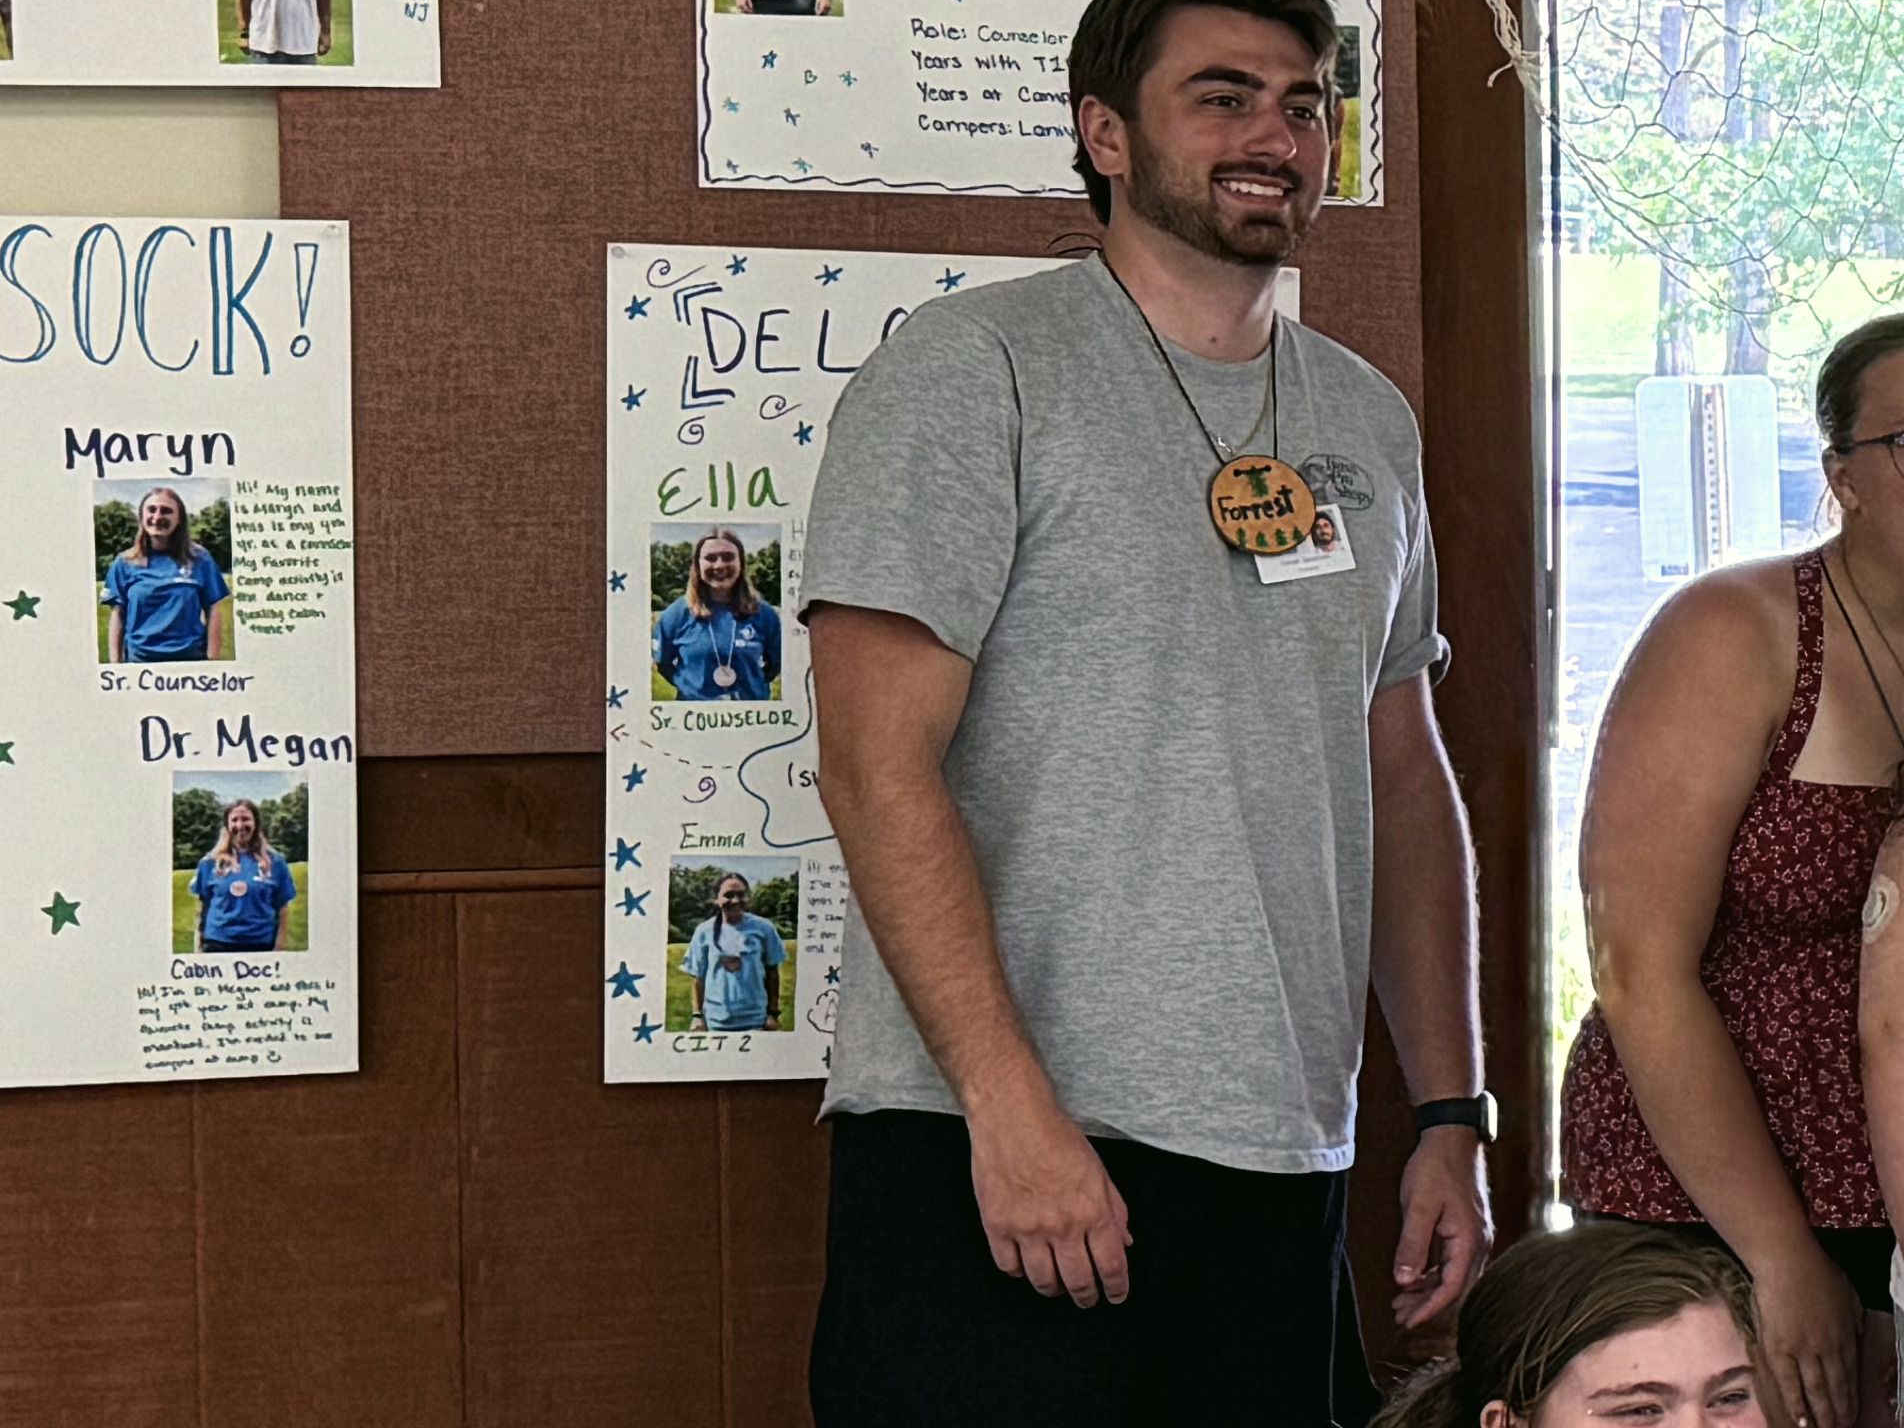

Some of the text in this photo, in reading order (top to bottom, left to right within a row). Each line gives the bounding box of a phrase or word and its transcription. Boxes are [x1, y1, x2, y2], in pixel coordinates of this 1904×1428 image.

[404, 2, 429, 22] NJ
[911, 18, 1069, 46] Role: Counselor
[911, 49, 1069, 73] Years with T1
[916, 81, 969, 102] Years
[982, 88, 1003, 101] at
[918, 113, 1013, 138] Campers:
[0, 222, 319, 376] SOCK!
[64, 427, 237, 479] Maryn
[295, 483, 341, 497] name
[657, 461, 790, 516] Ella
[1217, 483, 1294, 524] Forrest
[100, 668, 255, 694] Sr. Counselor
[684, 709, 799, 732] COUNSELOR
[139, 713, 355, 768] Dr. Megan
[679, 822, 746, 850] Emma
[171, 958, 281, 980] Cabin Doc!
[672, 1035, 752, 1053] CIT 2
